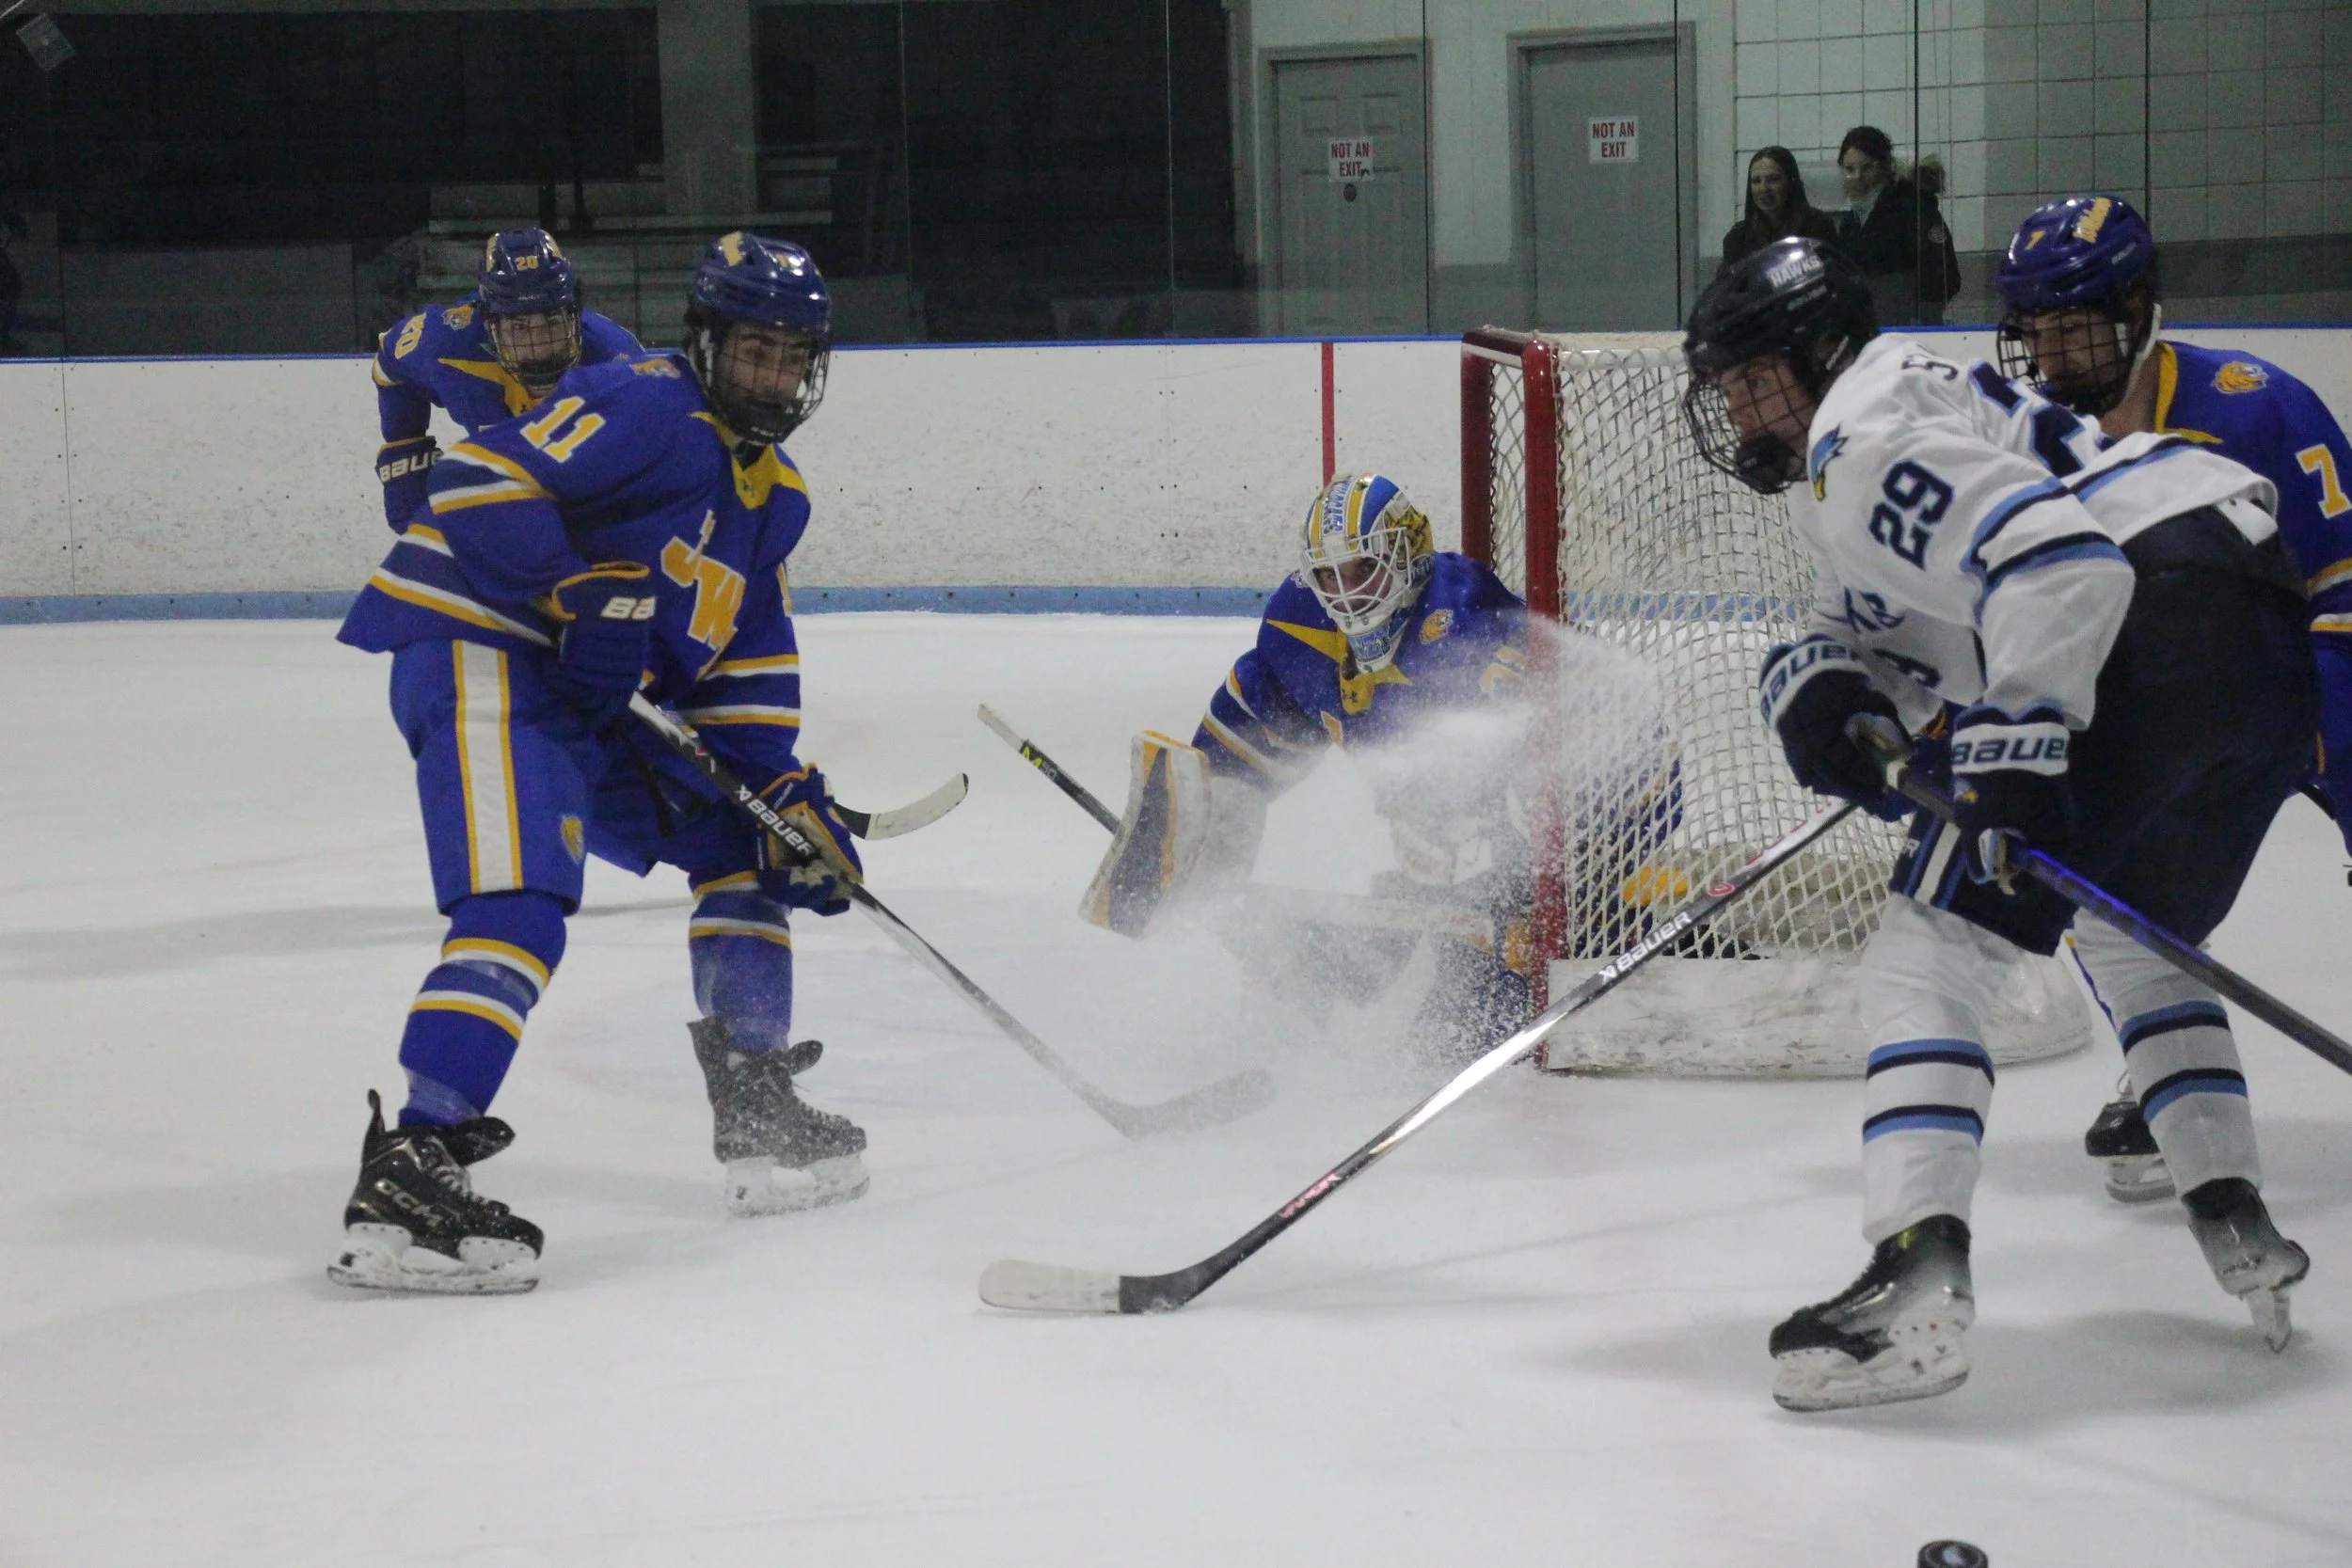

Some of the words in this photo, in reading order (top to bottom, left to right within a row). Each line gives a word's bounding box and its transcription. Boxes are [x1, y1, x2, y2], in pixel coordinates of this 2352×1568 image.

[1592, 122, 1615, 139] NOT
[1619, 120, 1635, 137] AN
[1330, 143, 1352, 158] NOT
[1355, 142, 1370, 158] AN
[1601, 141, 1627, 158] EXIT
[1339, 161, 1362, 177] EXIT
[515, 255, 538, 271] 20
[1767, 254, 1822, 288] HAWKS
[520, 396, 606, 463] 11
[2296, 443, 2352, 519] 7
[1868, 458, 1955, 571] 29
[1616, 911, 1692, 973] BAUER
